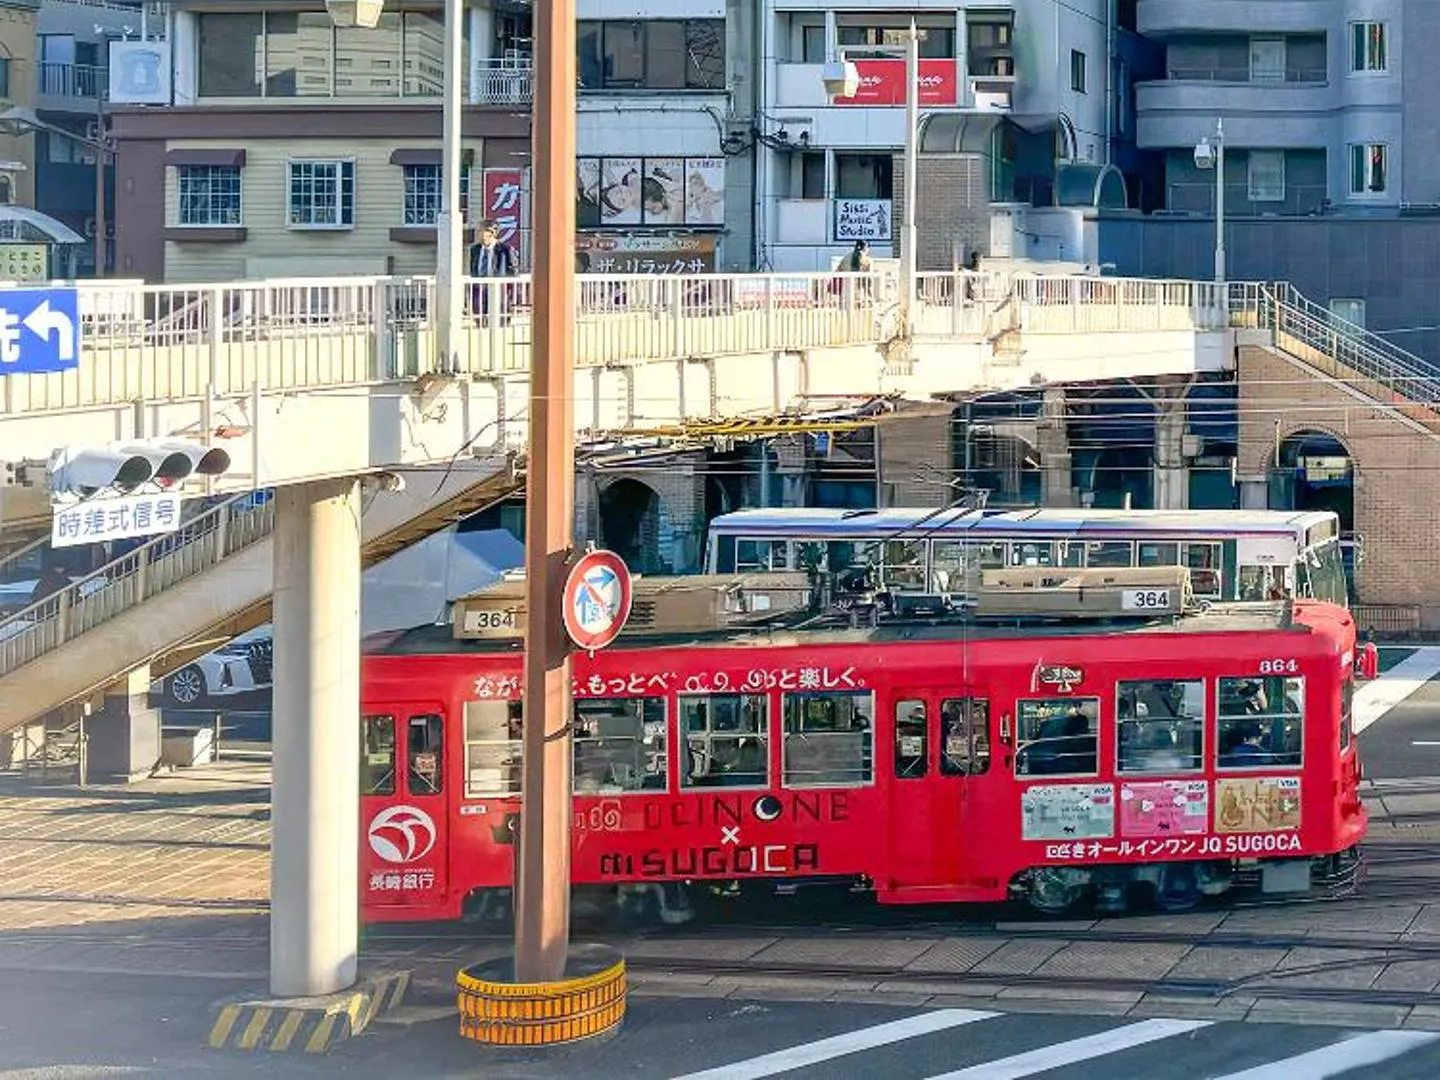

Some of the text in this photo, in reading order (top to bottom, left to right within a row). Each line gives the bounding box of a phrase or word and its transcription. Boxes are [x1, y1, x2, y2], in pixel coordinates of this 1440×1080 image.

[59, 499, 175, 538] 時差式信号
[1136, 592, 1168, 607] 364
[478, 613, 513, 628] 364
[1199, 835, 1221, 853] JQ
[1226, 833, 1303, 852] SUGOCA
